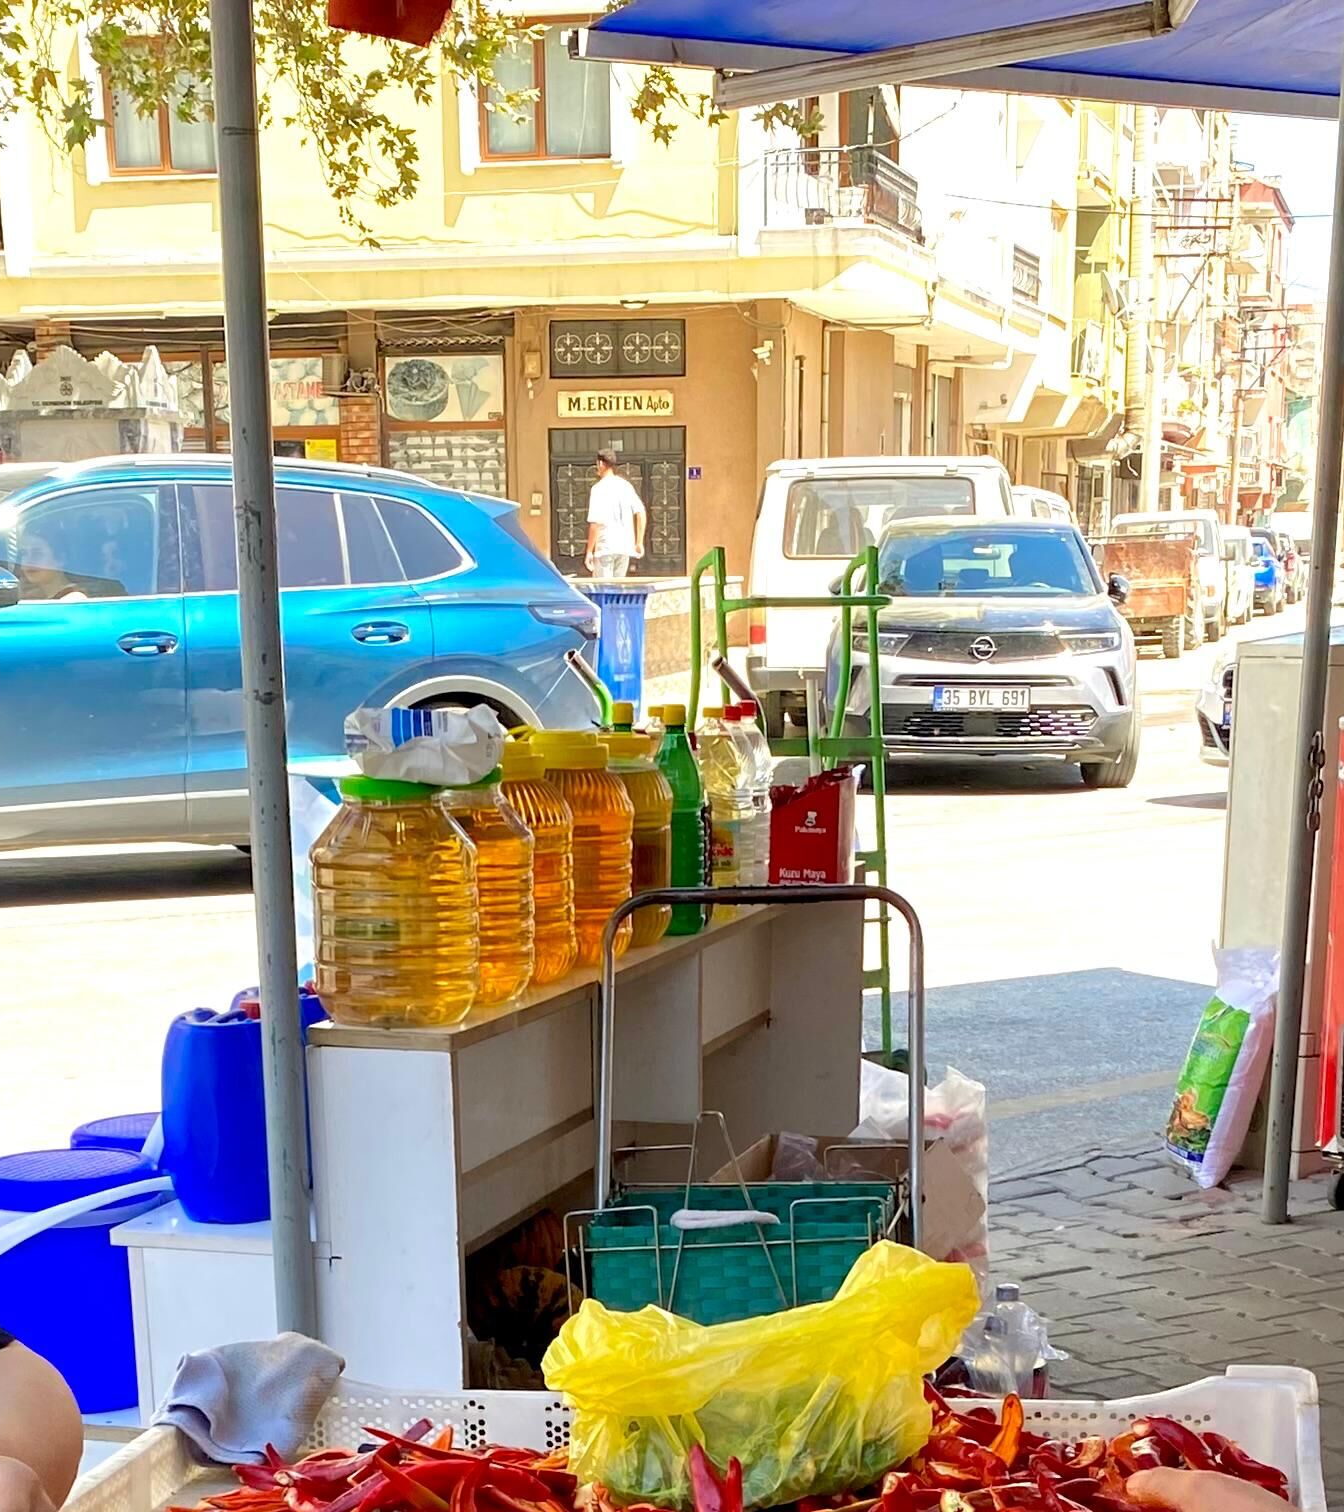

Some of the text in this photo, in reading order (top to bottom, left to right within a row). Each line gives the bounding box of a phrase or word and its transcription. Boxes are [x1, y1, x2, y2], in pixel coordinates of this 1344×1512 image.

[943, 689, 1026, 706] 35 BYL 691
[779, 867, 826, 881] Kuru Maya
